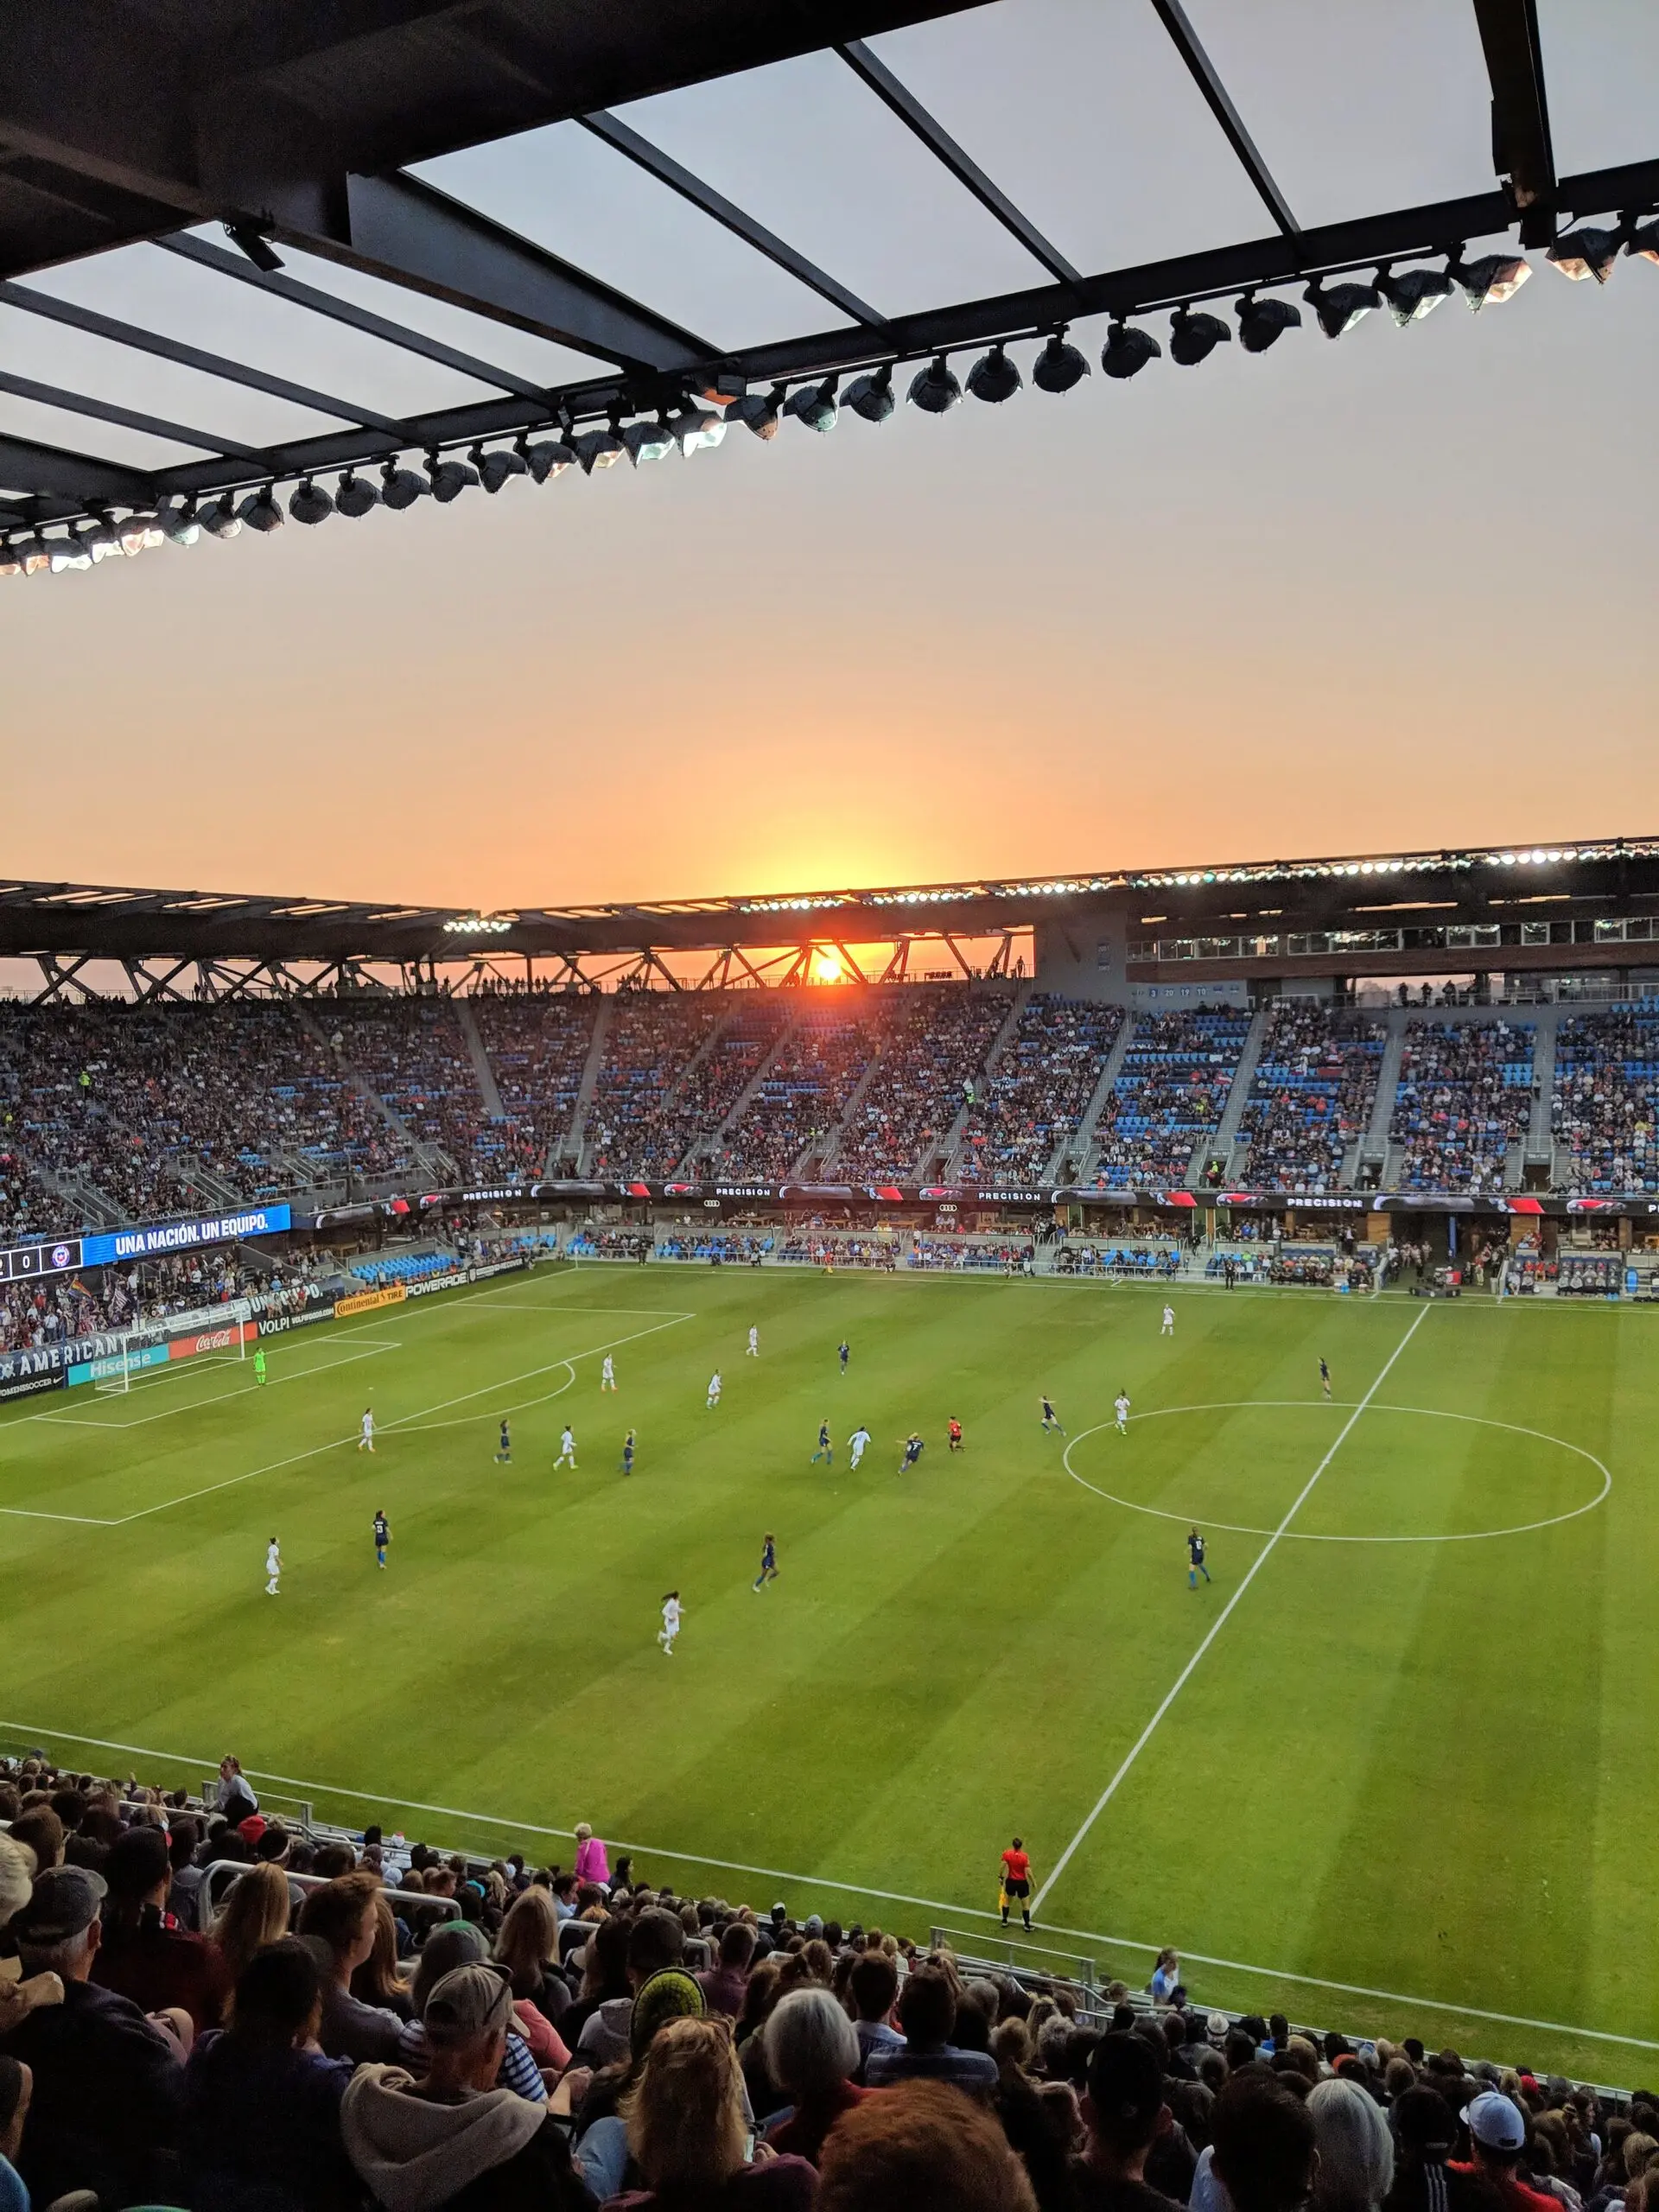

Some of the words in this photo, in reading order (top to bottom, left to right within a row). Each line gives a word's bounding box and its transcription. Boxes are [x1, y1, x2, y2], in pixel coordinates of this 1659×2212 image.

[462, 1189, 522, 1201] PRECISION
[978, 1192, 1040, 1201] PRECISION
[1287, 1198, 1363, 1208] PRECISION
[115, 1235, 145, 1256] UNA
[147, 1224, 200, 1250] NACIÓN.
[201, 1220, 220, 1239] UN
[221, 1213, 269, 1236] EQUIPO.
[22, 1255, 30, 1269] 0
[405, 1272, 467, 1297] POWERADE
[337, 1294, 379, 1316] Continental
[387, 1290, 404, 1300] TIRE
[258, 1316, 290, 1336] VOLPI
[20, 1335, 118, 1376] AMERICAN
[0, 1377, 52, 1397] OMENSSOCCER
